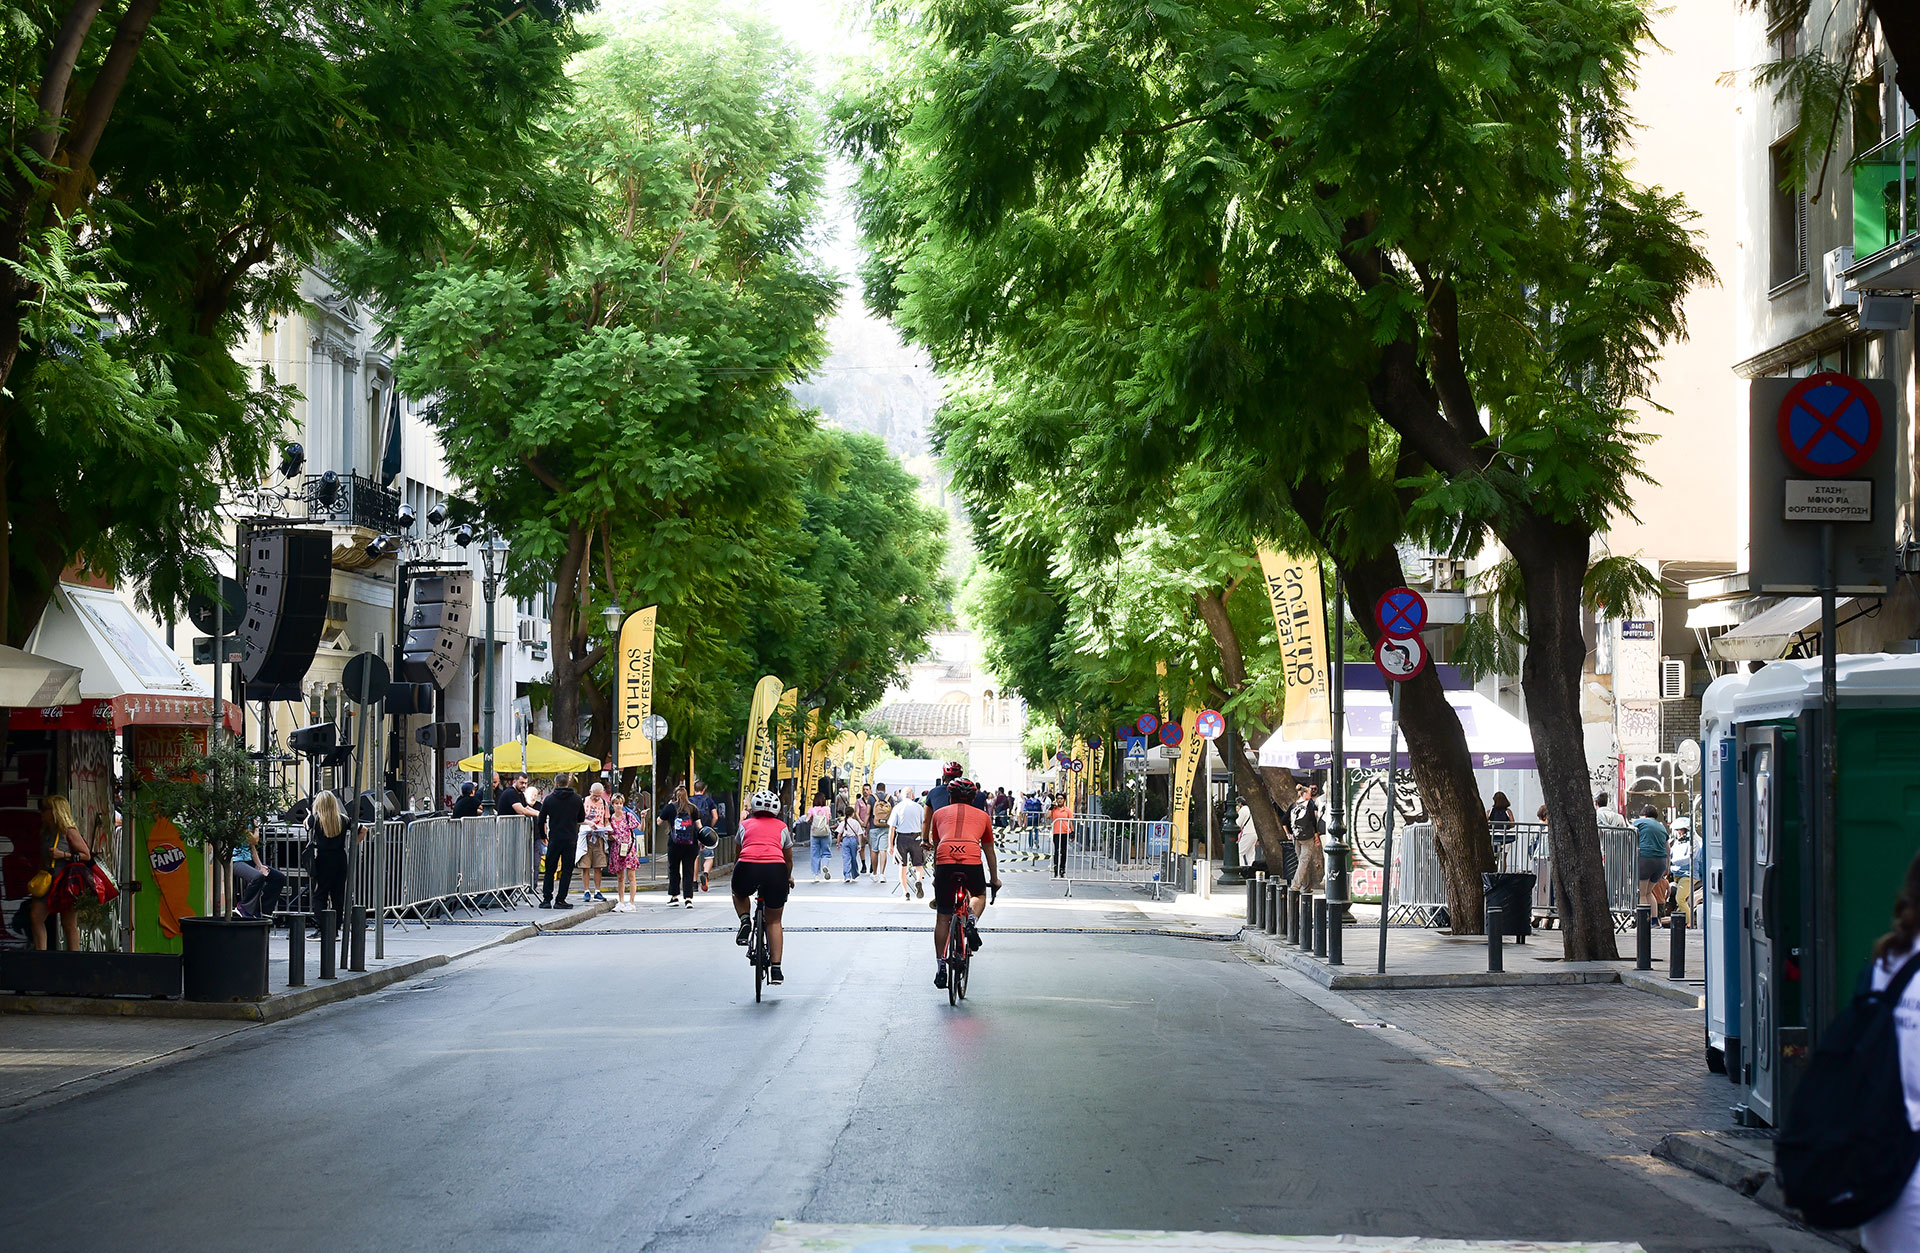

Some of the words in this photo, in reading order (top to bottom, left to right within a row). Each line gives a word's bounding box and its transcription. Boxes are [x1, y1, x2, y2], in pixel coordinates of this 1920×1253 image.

[1788, 505, 1868, 515] ΦΟΡΤΩΕΚΦΟΡΤΩΣΗ
[1807, 496, 1834, 504] ΜΟΝΟ
[641, 648, 652, 699] FESTIVAL
[642, 701, 650, 723] ITY
[624, 731, 631, 740] IS
[1174, 786, 1183, 812] THIS
[150, 848, 186, 869] FANTA
